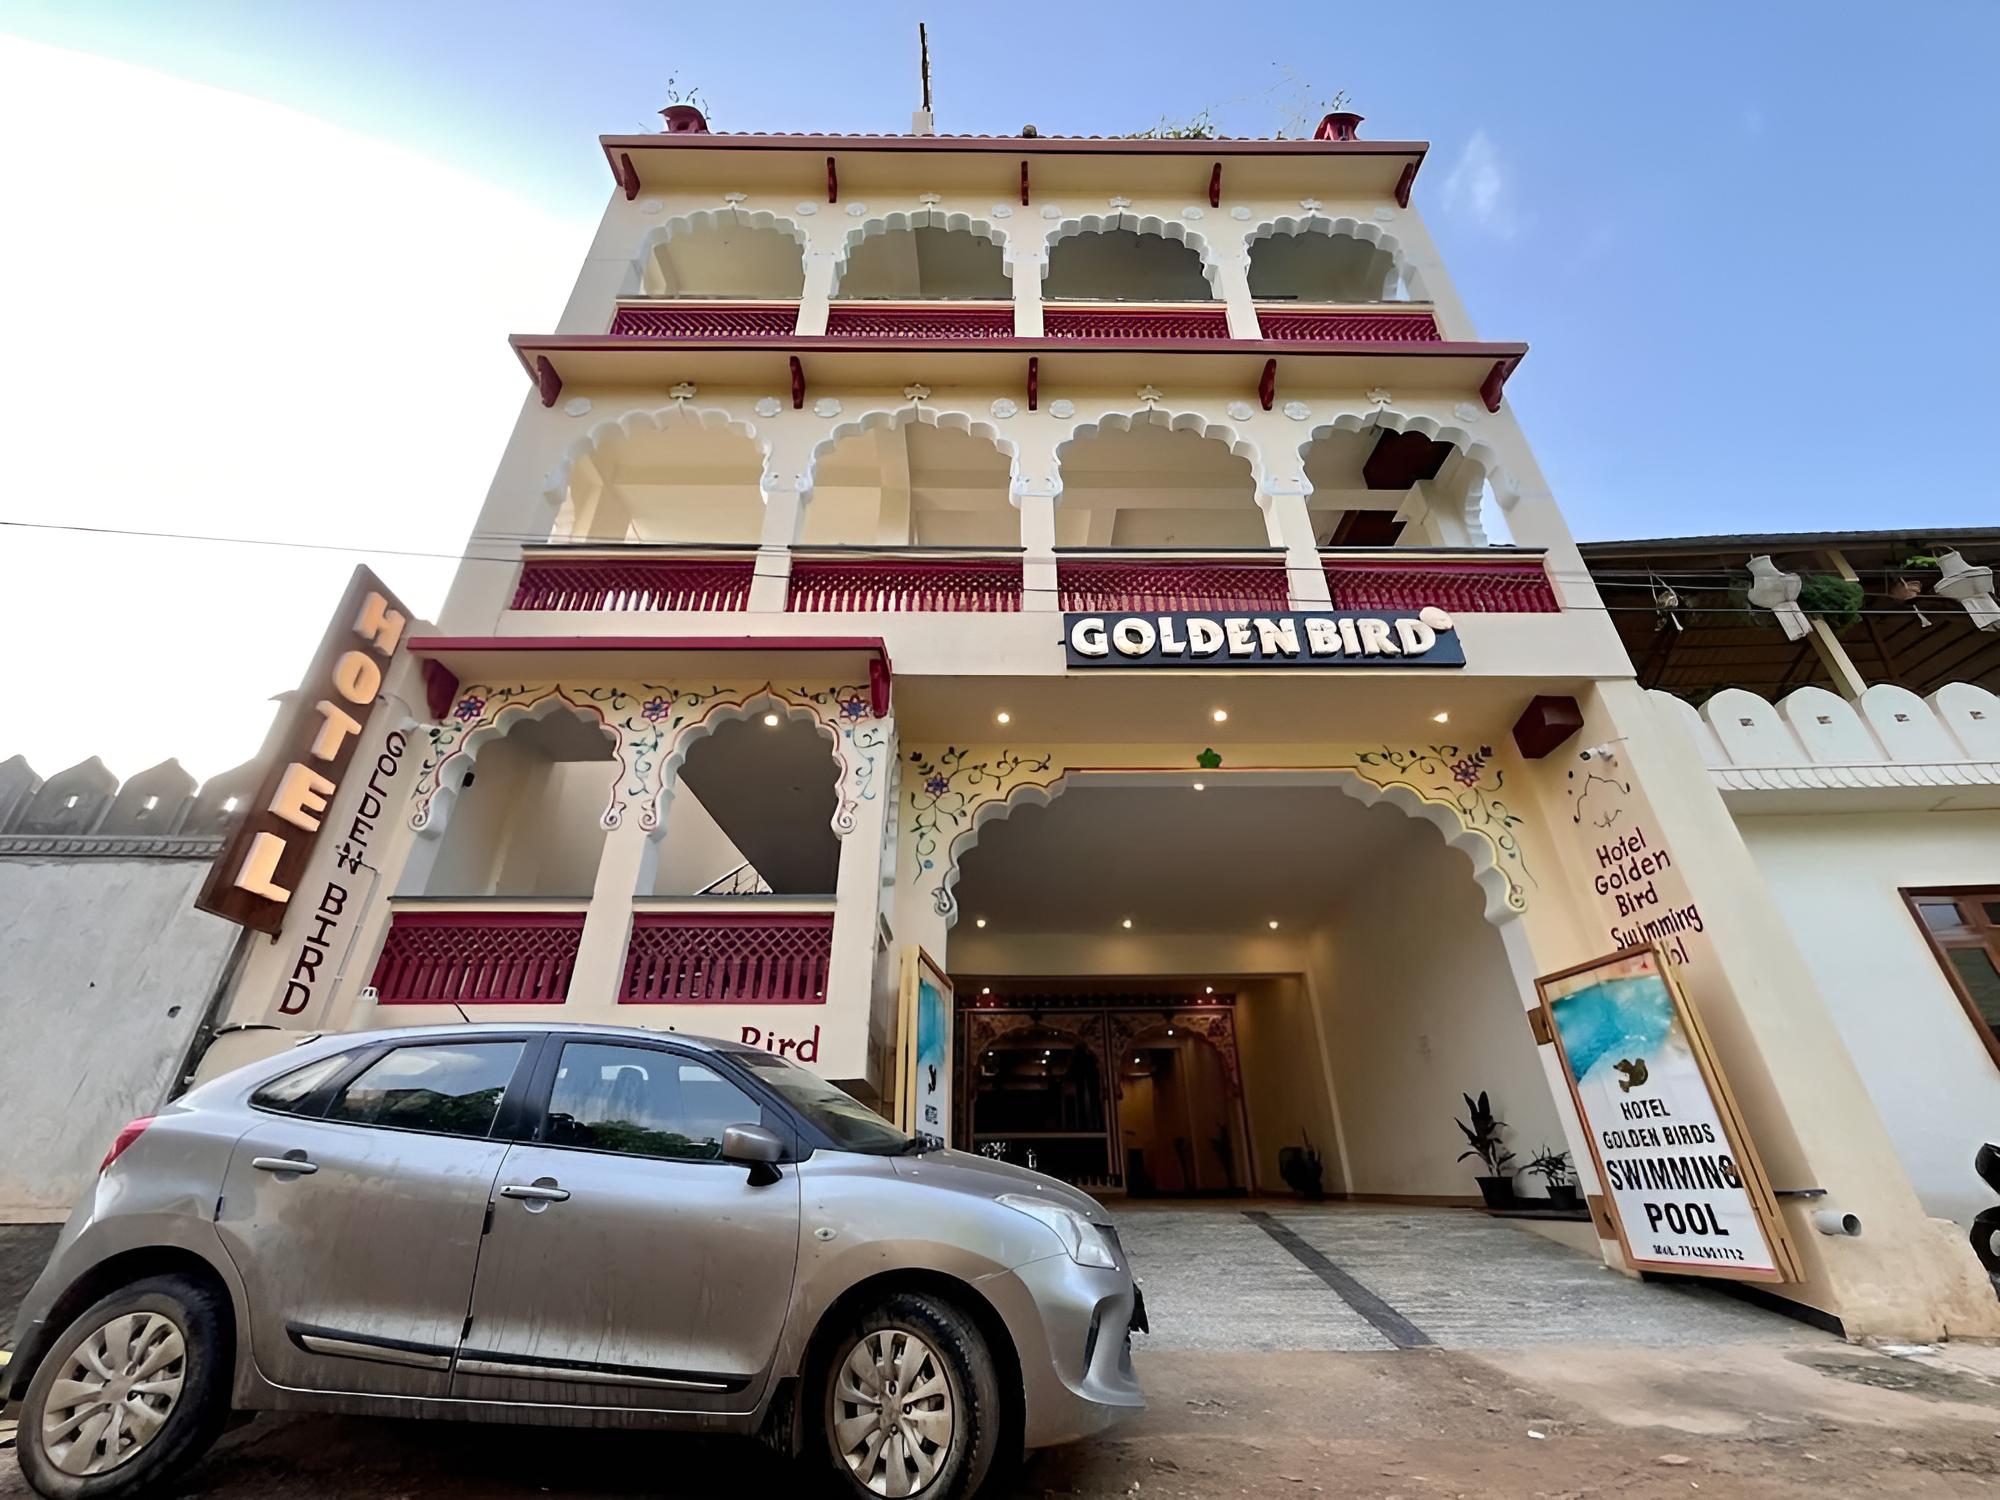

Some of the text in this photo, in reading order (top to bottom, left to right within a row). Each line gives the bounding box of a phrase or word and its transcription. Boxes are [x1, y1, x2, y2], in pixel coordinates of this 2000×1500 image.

[1071, 617, 1437, 656] GOLDEN BIRD
[234, 591, 406, 903] HOTEL
[1596, 827, 1647, 868] Hotel
[278, 731, 406, 1015] GOLDEN BIRD
[1595, 850, 1671, 895] Golden
[1615, 881, 1659, 917] Bird
[1611, 904, 1704, 951] Swimming
[1620, 1098, 1671, 1121] HOTEL
[1602, 1123, 1716, 1150] GOLDEN BIRDS
[1606, 1155, 1744, 1191] SWIMMING
[1644, 1203, 1730, 1236] POOL
